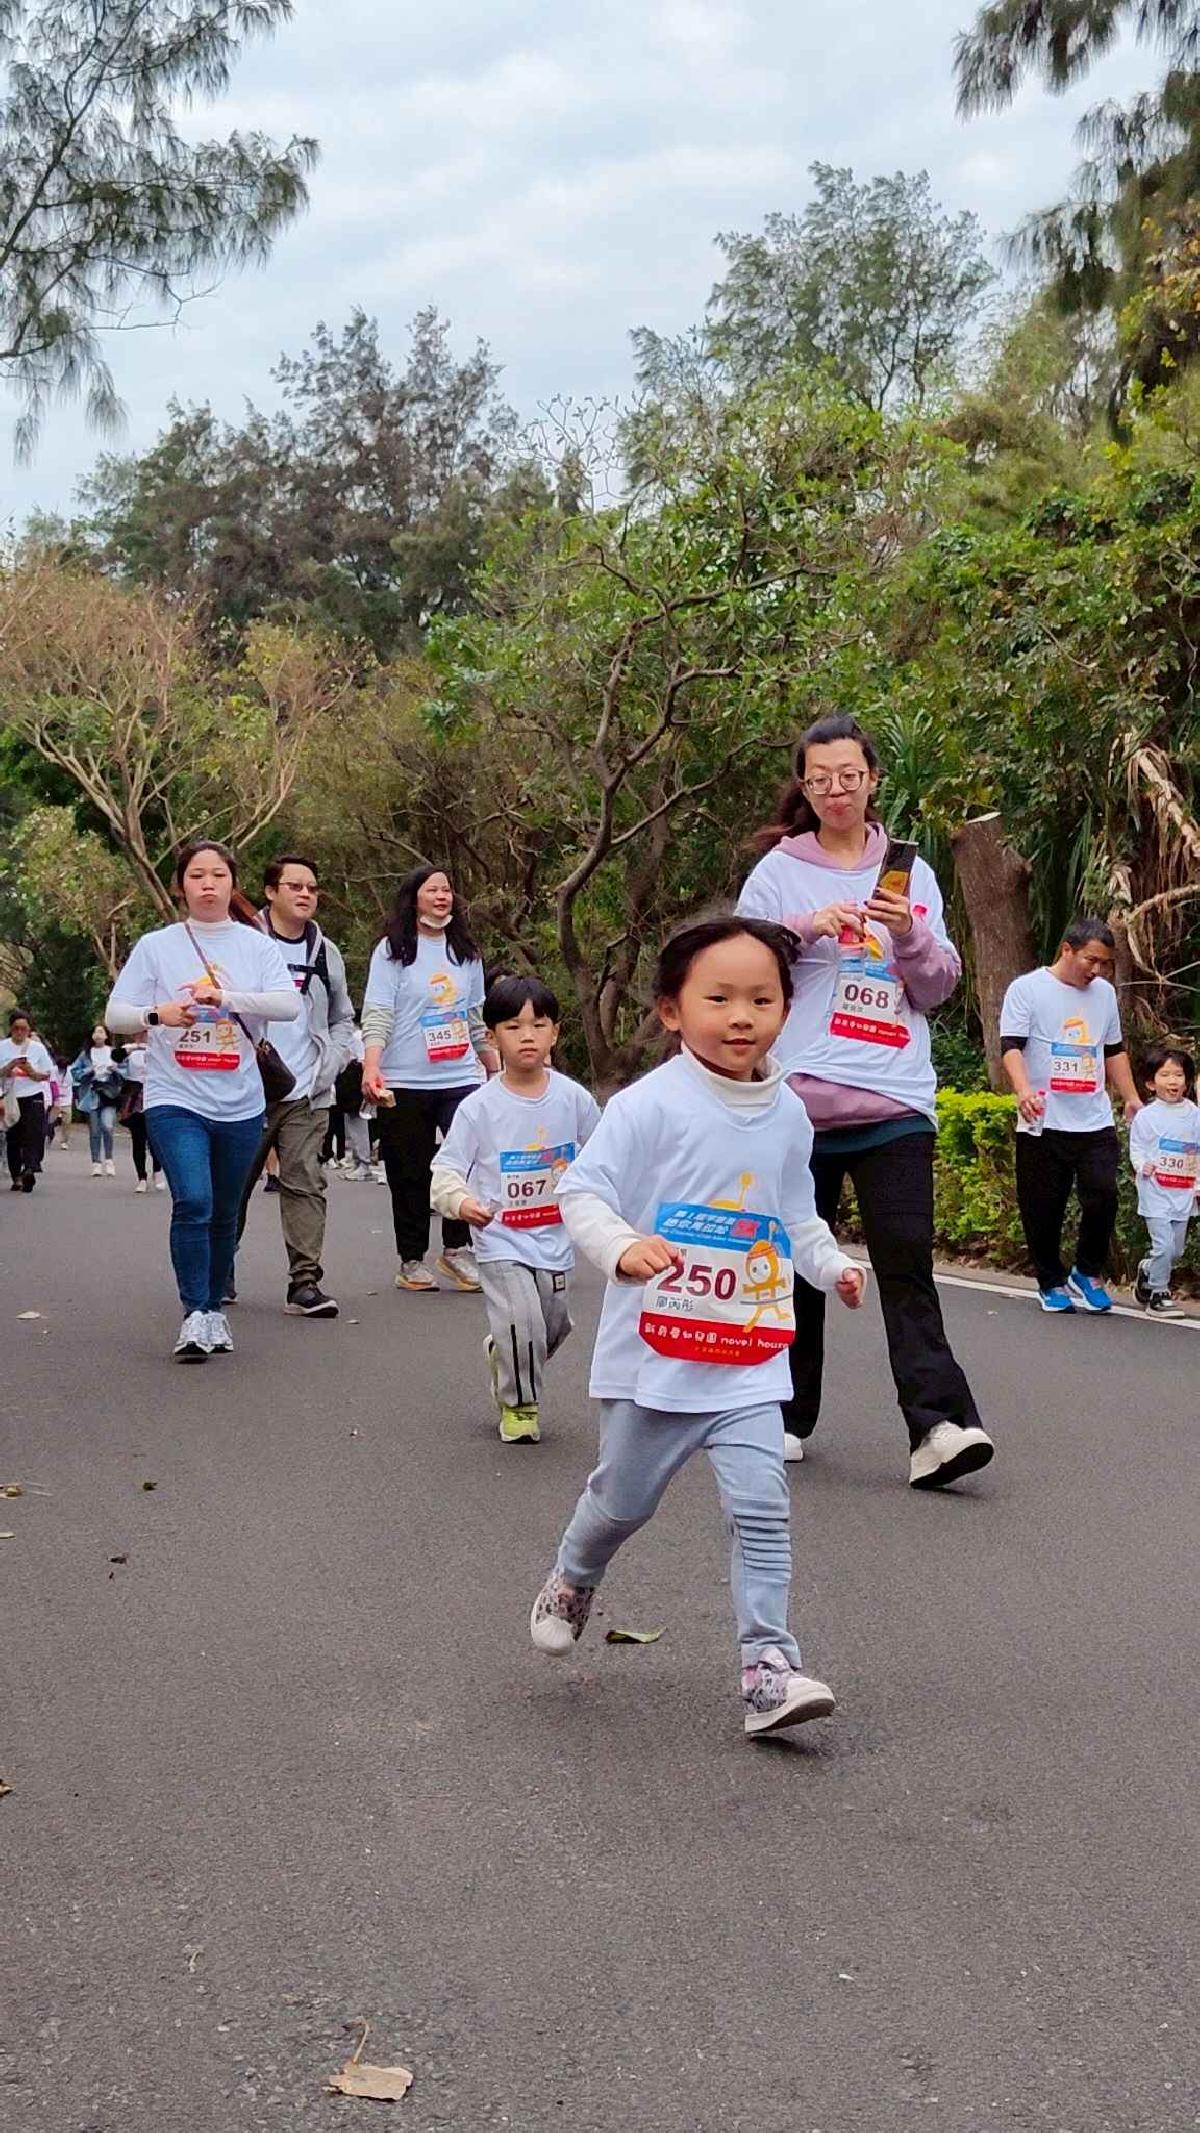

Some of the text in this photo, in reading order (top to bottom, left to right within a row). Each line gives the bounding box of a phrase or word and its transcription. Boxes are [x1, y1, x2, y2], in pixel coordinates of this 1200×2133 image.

[843, 983, 889, 1009] 068
[180, 1030, 211, 1043] 251
[429, 1030, 452, 1042] 345
[1054, 1061, 1078, 1072] 331
[1160, 1156, 1184, 1169] 330
[507, 1180, 547, 1198] 067
[656, 1258, 737, 1300] 250
